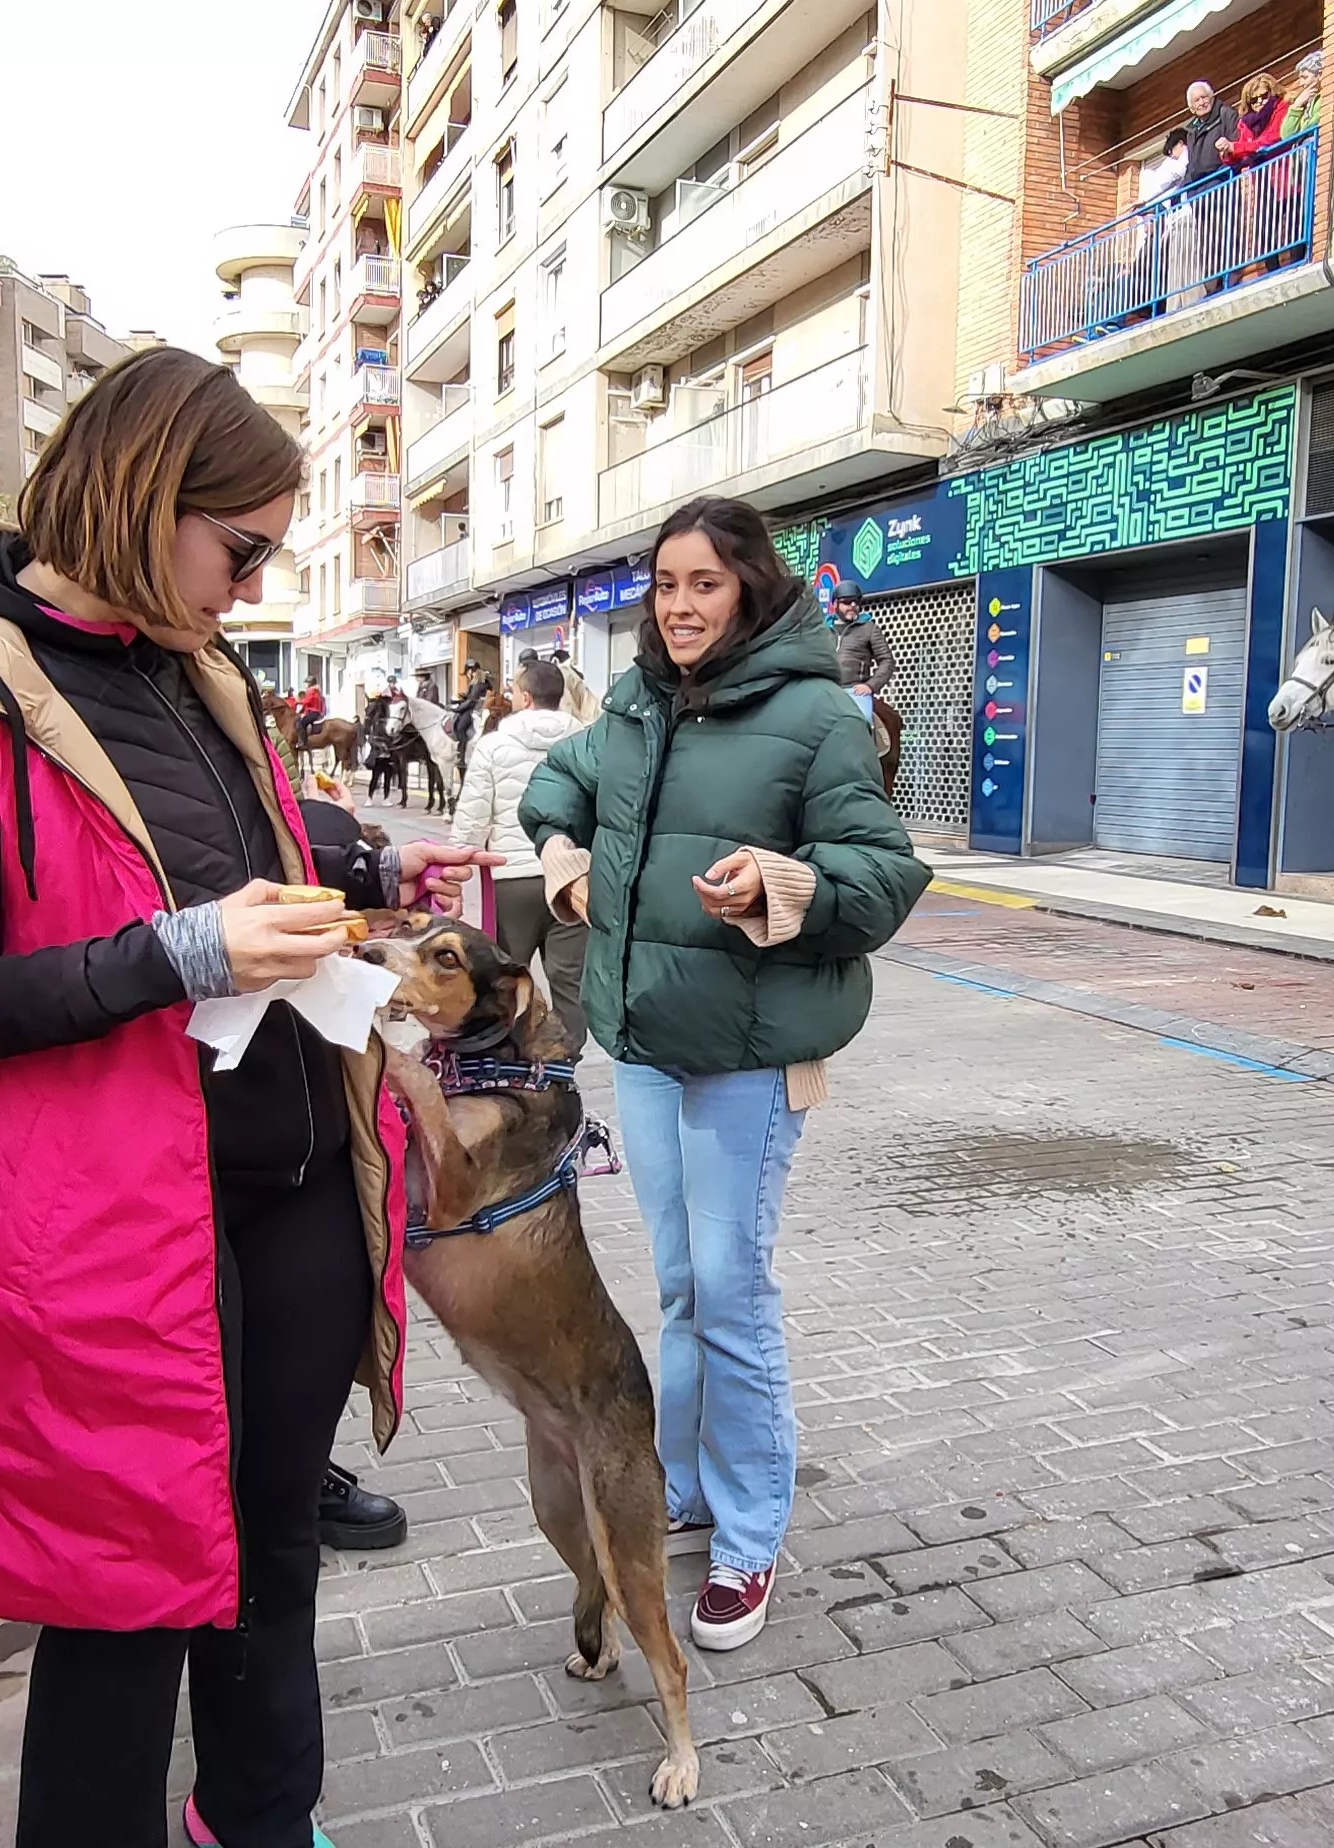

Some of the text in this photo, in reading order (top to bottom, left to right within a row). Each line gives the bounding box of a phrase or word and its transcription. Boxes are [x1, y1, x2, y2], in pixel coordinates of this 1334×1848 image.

[888, 514, 921, 538] Zynk
[888, 535, 931, 552] soluciones
[887, 550, 922, 565] digitales
